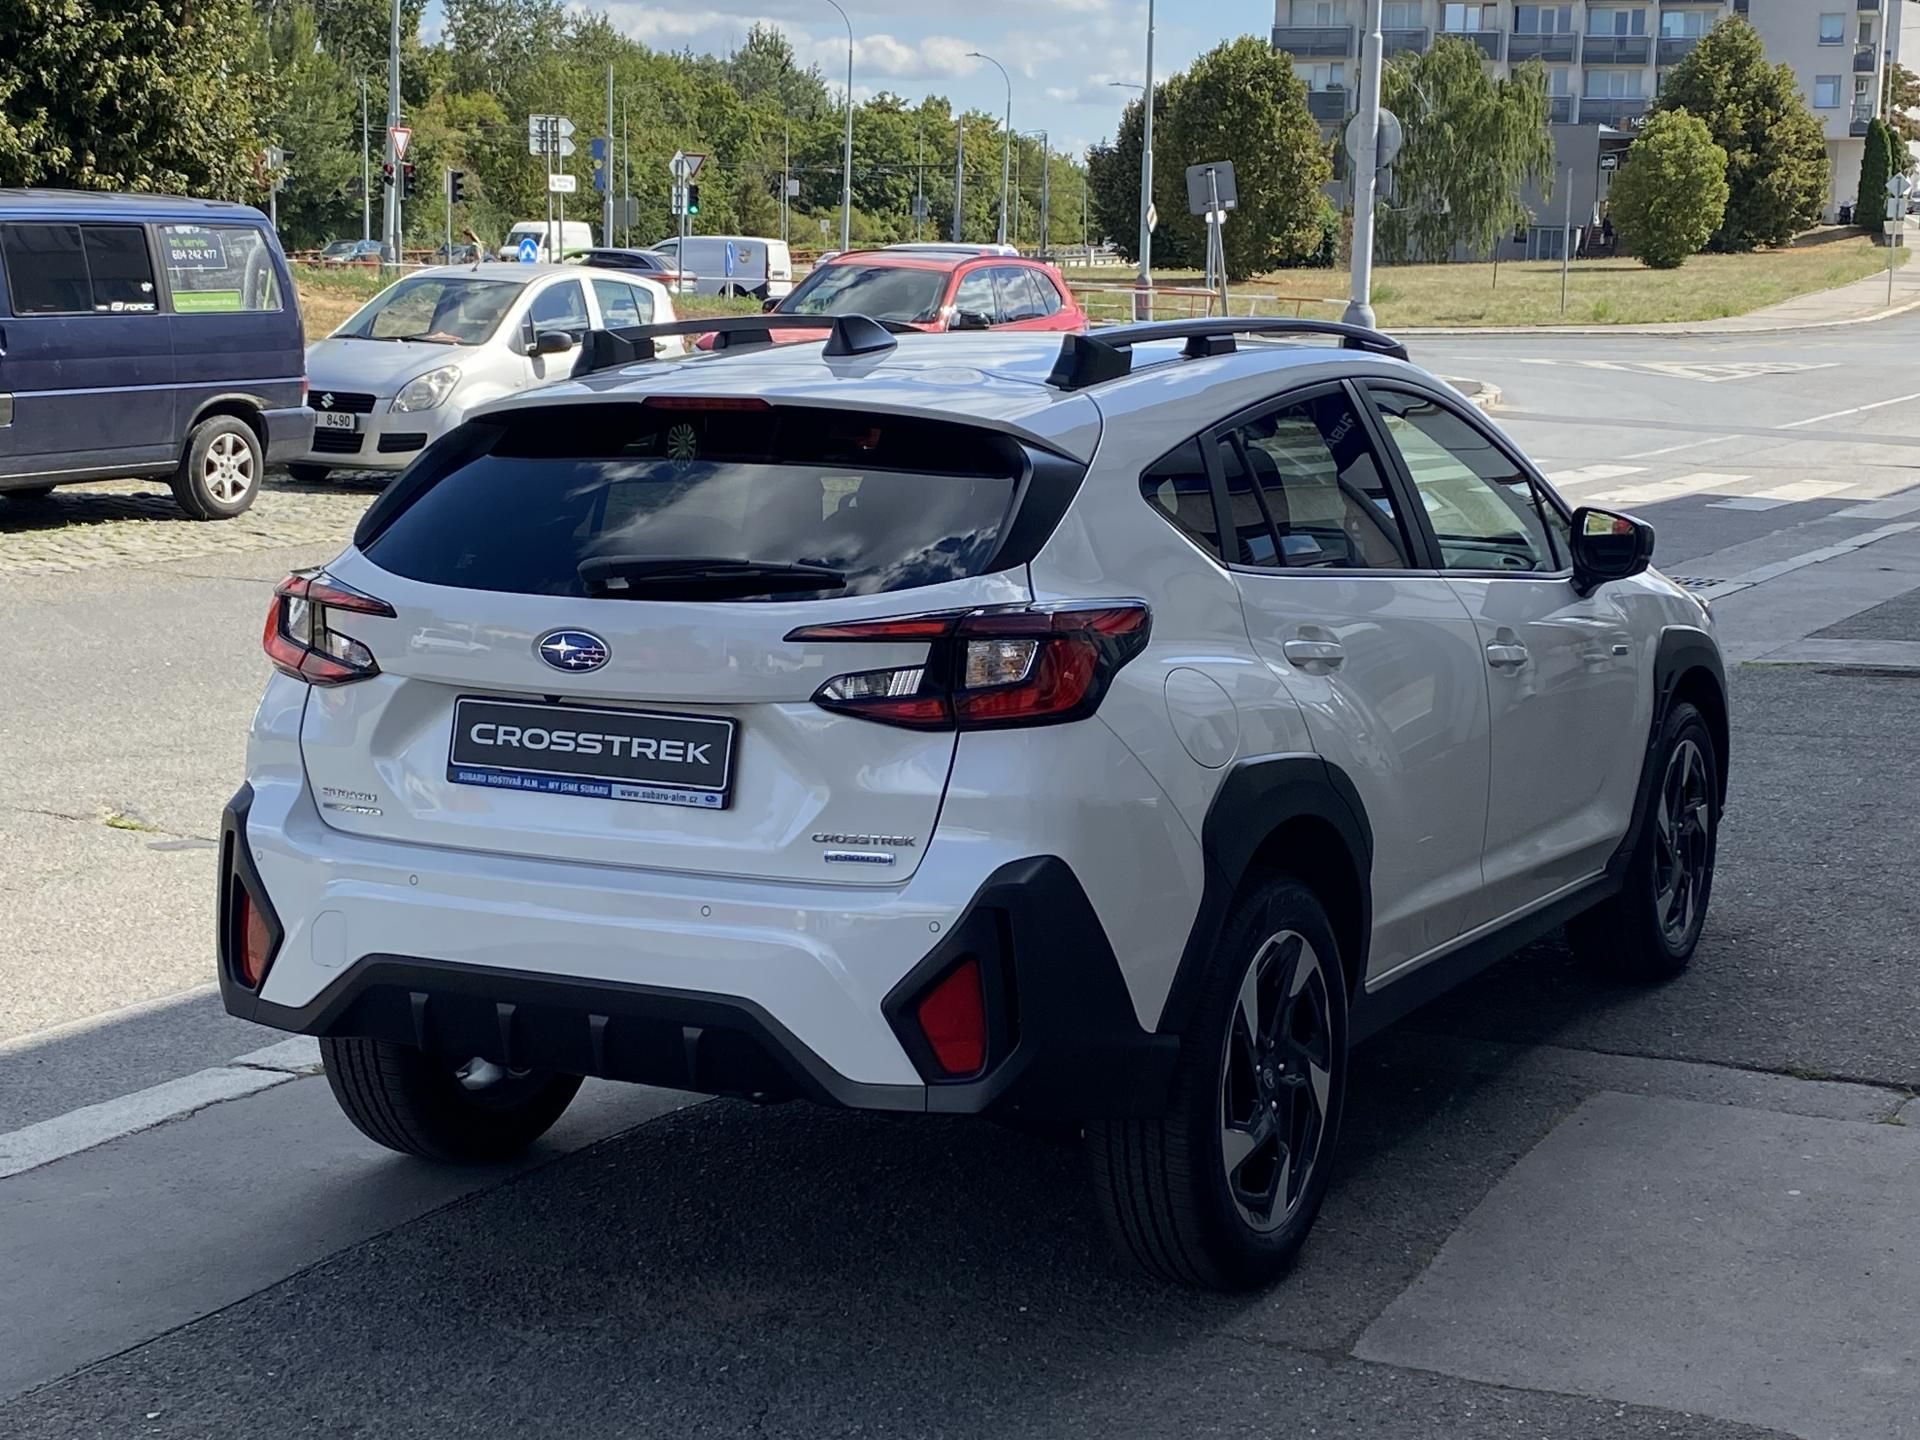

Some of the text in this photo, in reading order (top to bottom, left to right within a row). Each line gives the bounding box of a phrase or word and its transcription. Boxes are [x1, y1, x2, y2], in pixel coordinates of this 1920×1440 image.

[188, 249, 203, 260] 242
[326, 413, 351, 427] 8490
[470, 723, 711, 764] CROSSTREK
[459, 772, 487, 783] SUBARU
[487, 774, 522, 786] HOSTIVAŘ
[523, 778, 538, 788] ALM
[548, 781, 559, 790] MY
[560, 783, 578, 792] JSME
[580, 783, 609, 795] SUBARU
[620, 789, 698, 803] www.subaru-alm.cz
[812, 832, 916, 847] CROSSTREK
